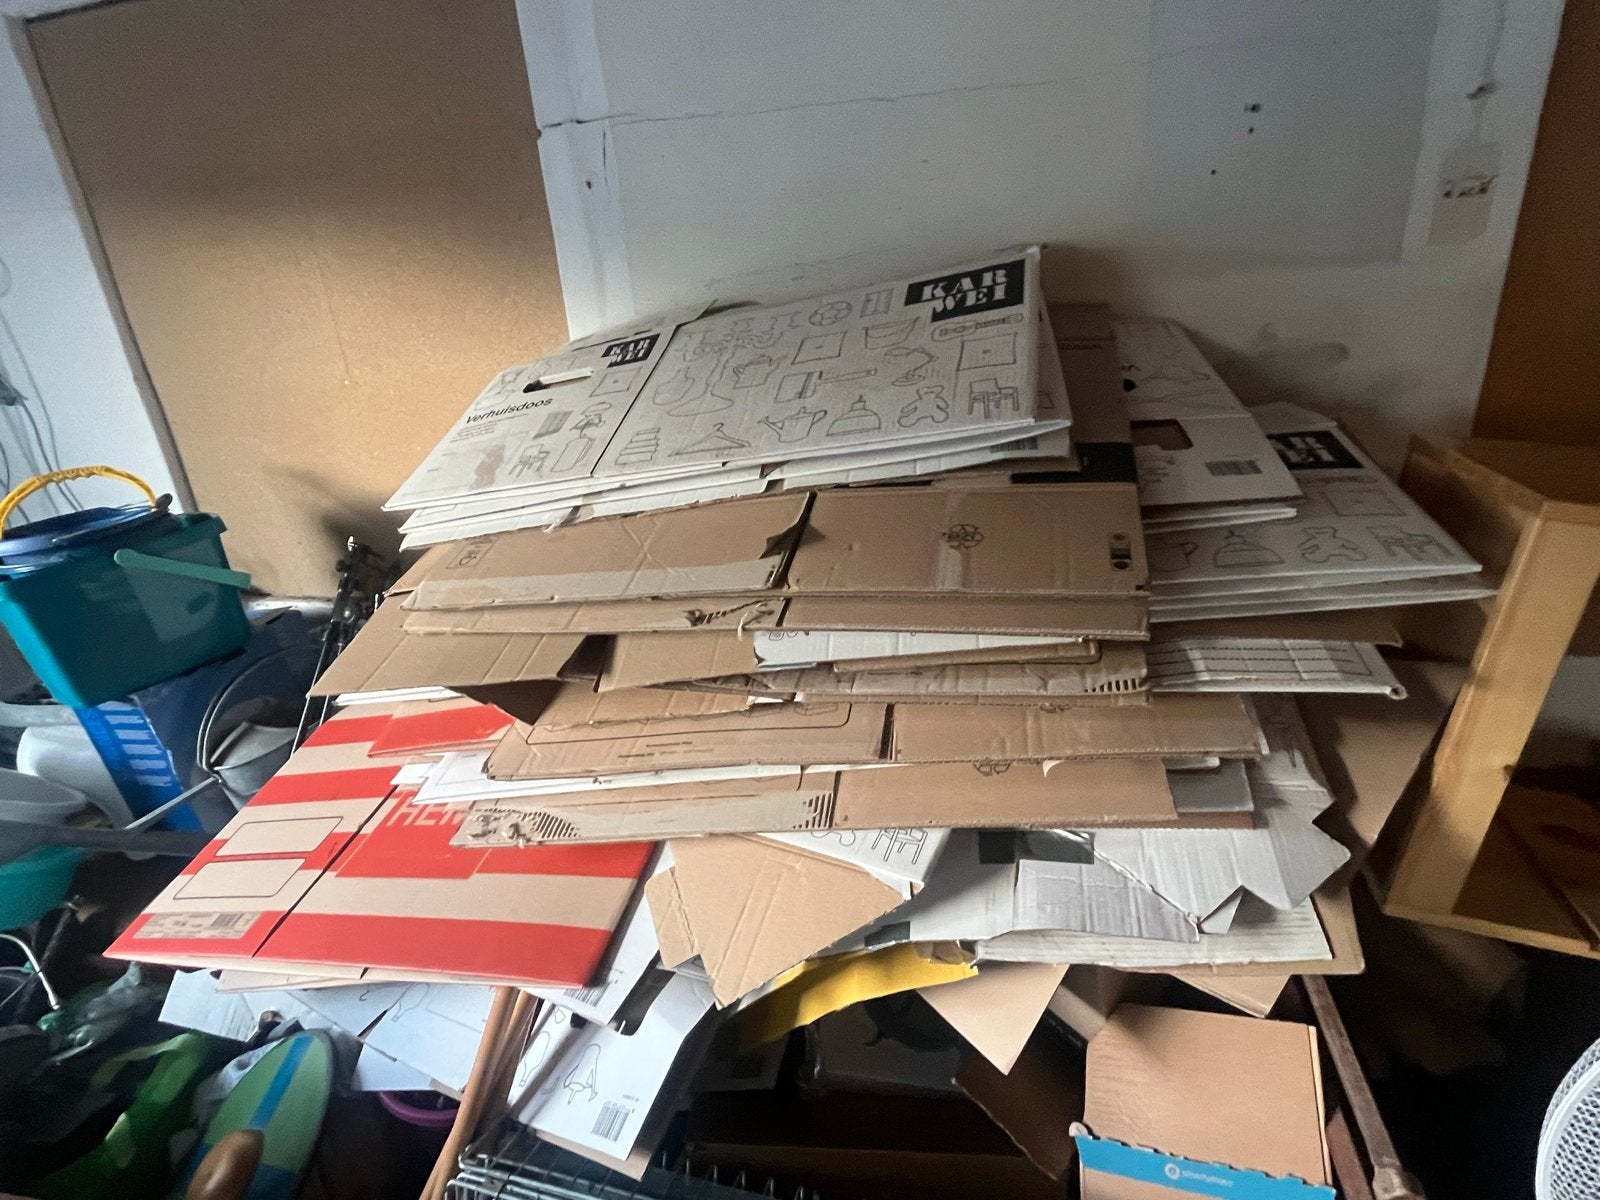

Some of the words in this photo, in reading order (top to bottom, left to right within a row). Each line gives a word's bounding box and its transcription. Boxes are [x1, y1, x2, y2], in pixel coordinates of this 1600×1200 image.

[920, 269, 1008, 301] KAR
[931, 283, 1007, 313] WEI
[609, 339, 651, 356] KAR
[610, 349, 646, 364] WEI
[466, 398, 553, 424] Verhuisdoos
